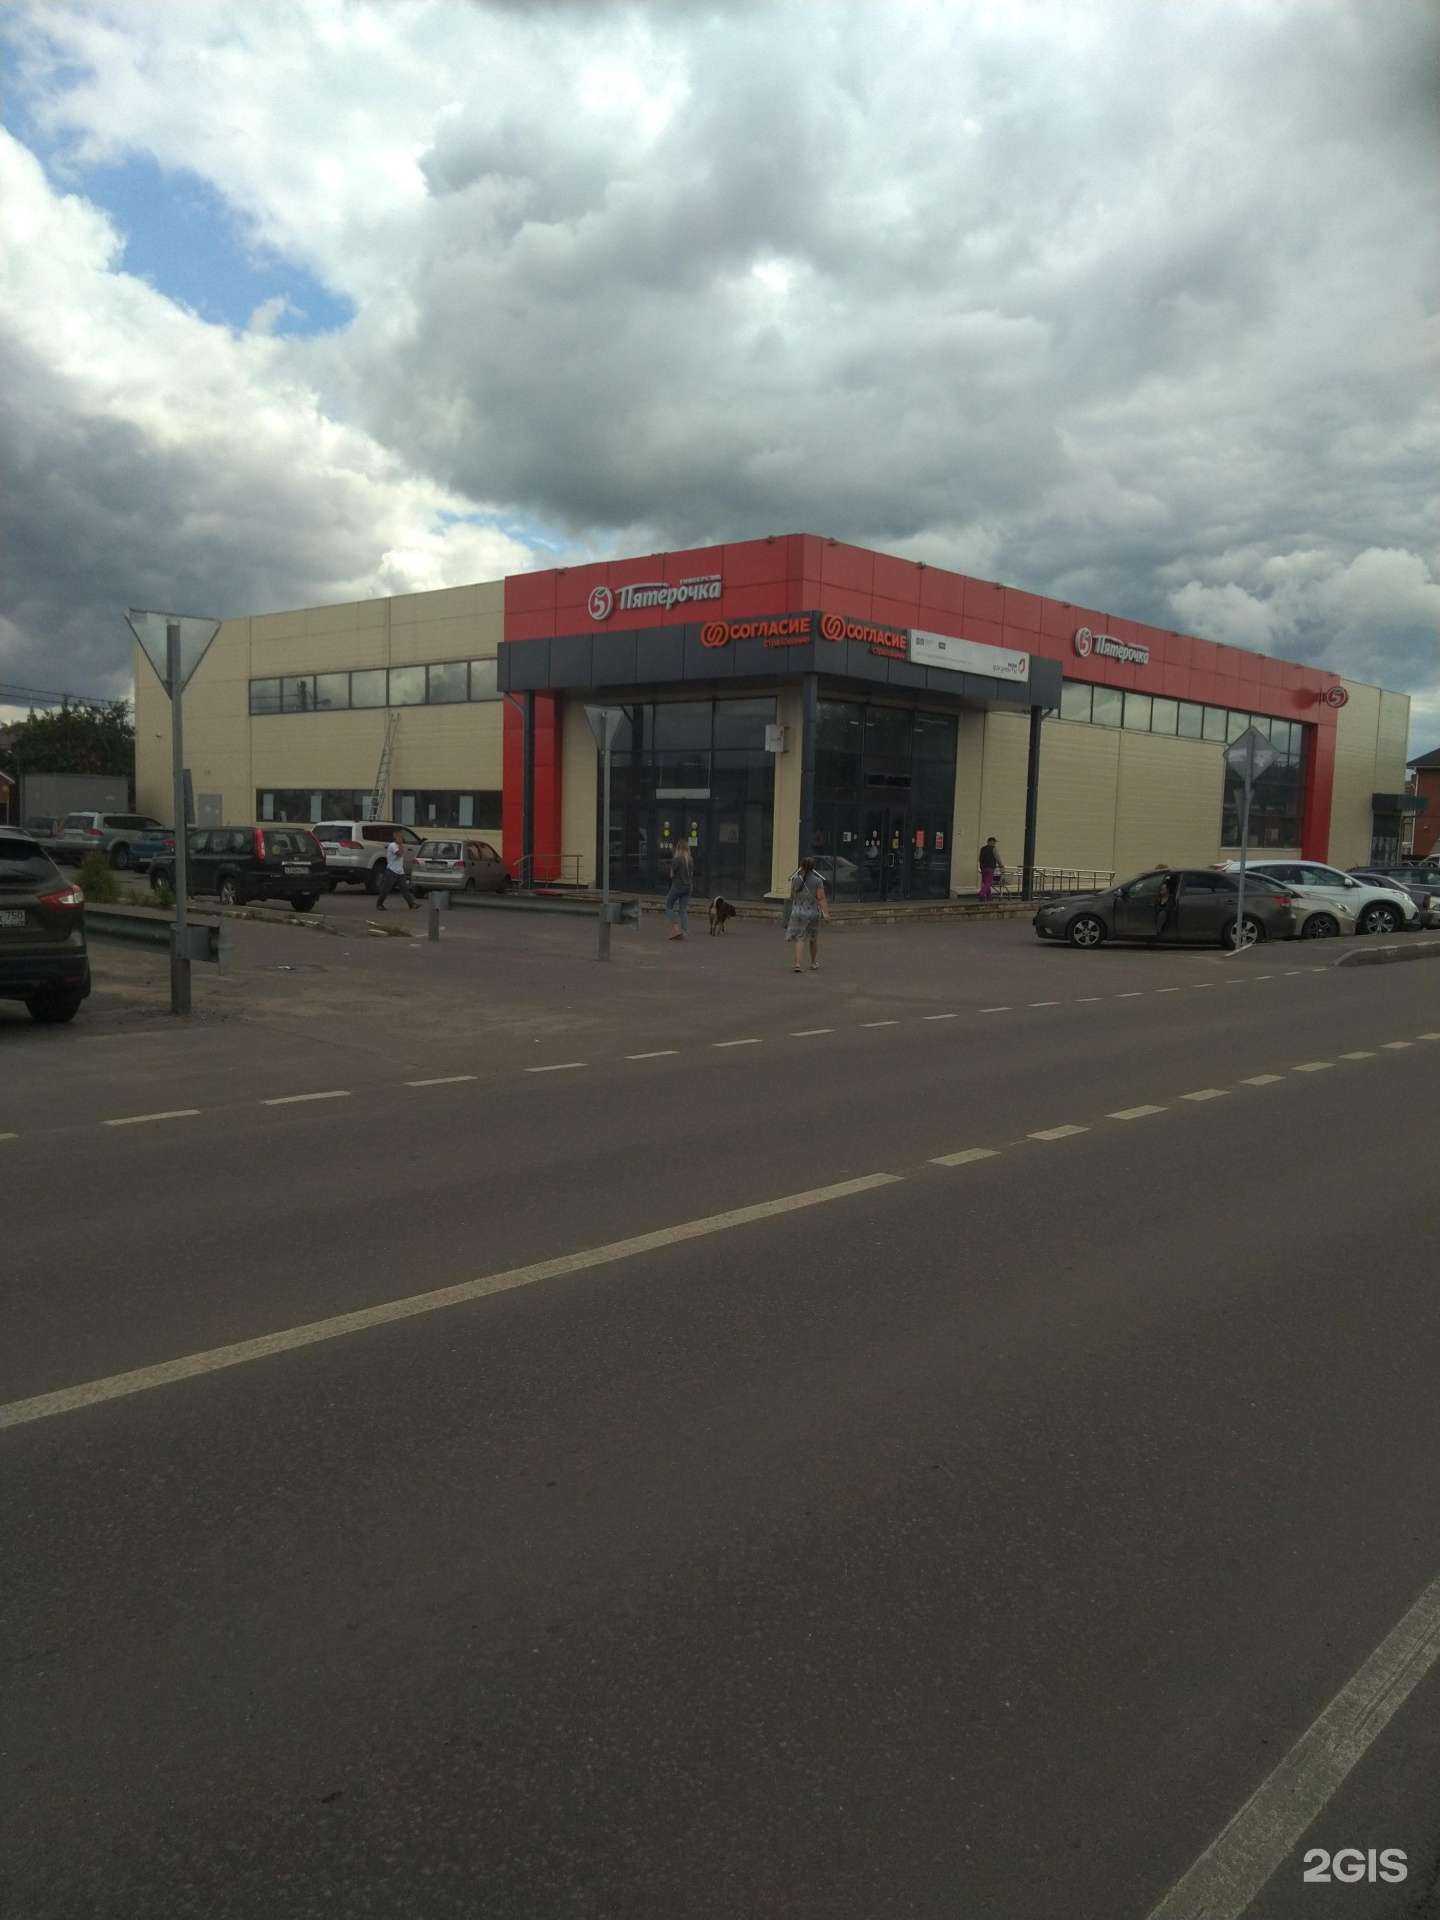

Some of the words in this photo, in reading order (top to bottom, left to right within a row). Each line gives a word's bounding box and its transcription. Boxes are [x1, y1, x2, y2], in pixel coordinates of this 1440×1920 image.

[616, 582, 721, 610] Пятерочка
[730, 618, 811, 639] СОГЛАСИЕ
[846, 624, 907, 649] СОГЛАСИЕ
[1094, 635, 1150, 664] Пятерочка
